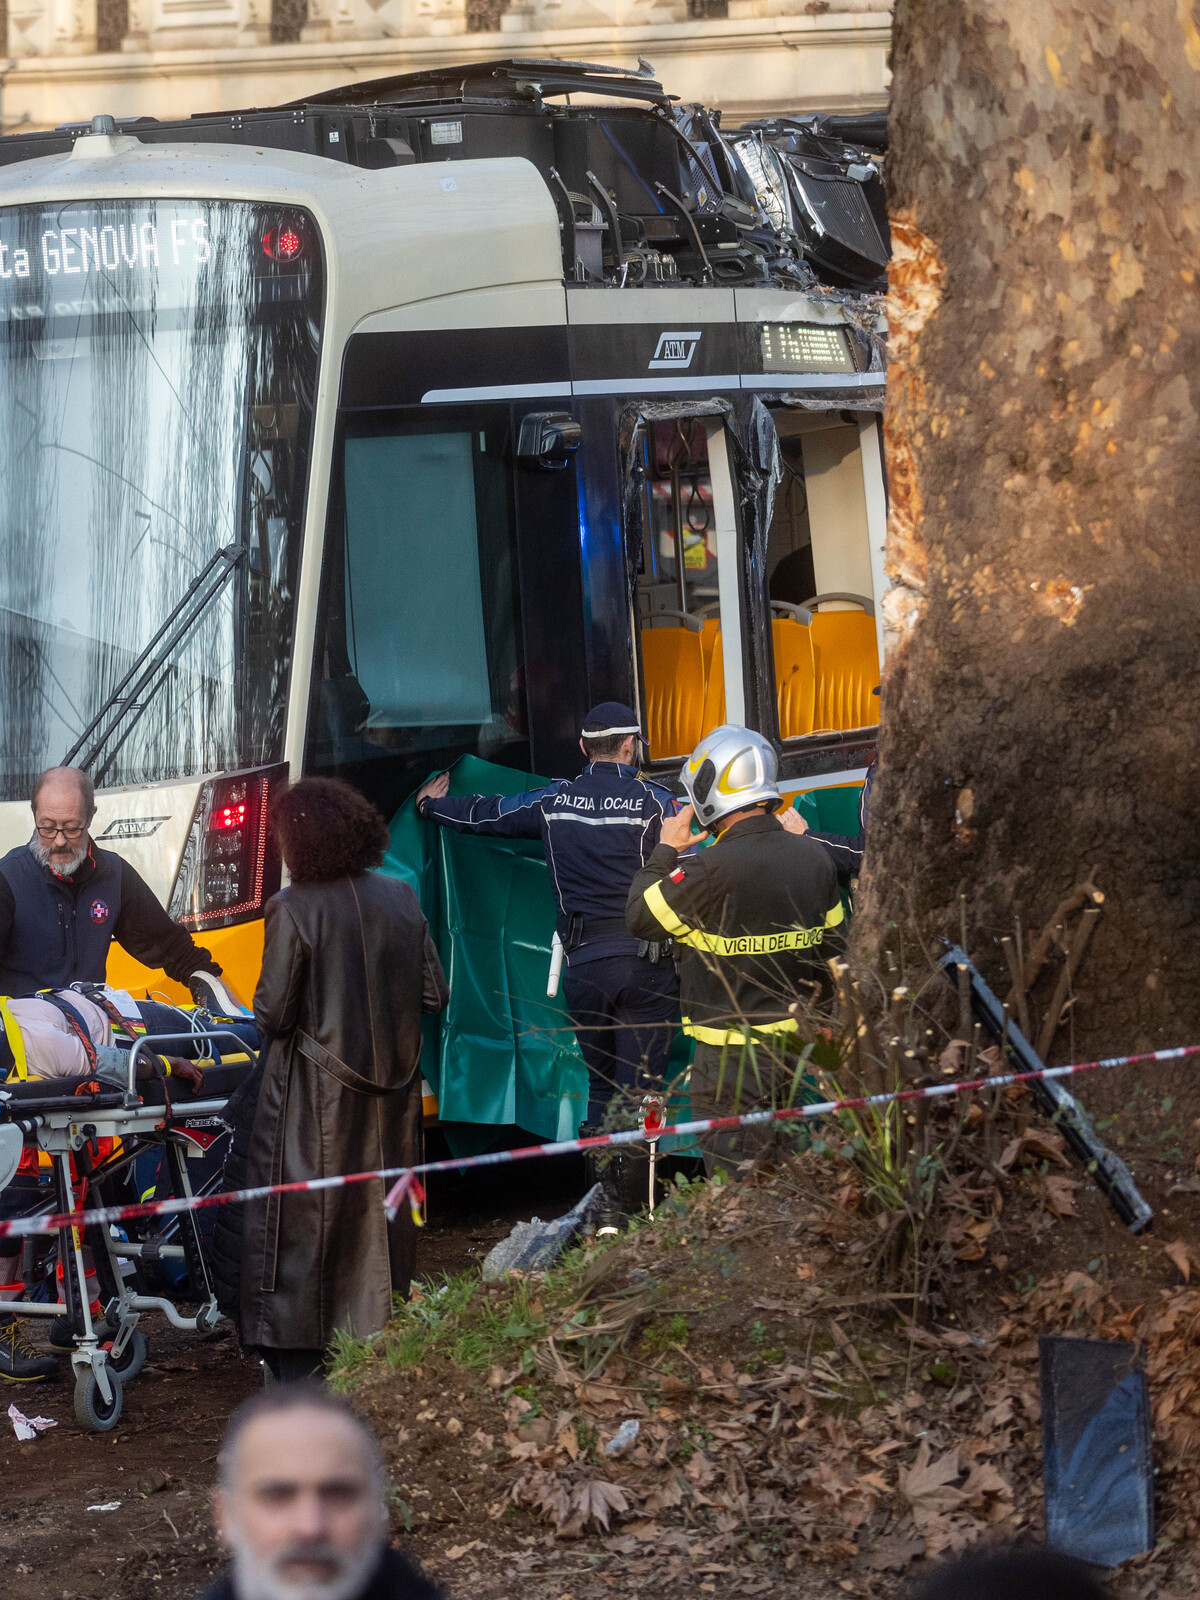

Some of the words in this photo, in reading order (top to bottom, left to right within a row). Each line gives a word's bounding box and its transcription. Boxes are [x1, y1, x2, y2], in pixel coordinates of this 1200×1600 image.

[41, 222, 159, 275] GENOVA
[171, 218, 211, 266] FS
[664, 341, 686, 360] ATM
[553, 793, 596, 811] POLIZIA
[599, 796, 644, 812] LOCALE
[116, 822, 148, 835] ATM
[723, 937, 765, 954] VIGILI
[768, 934, 791, 951] DEL
